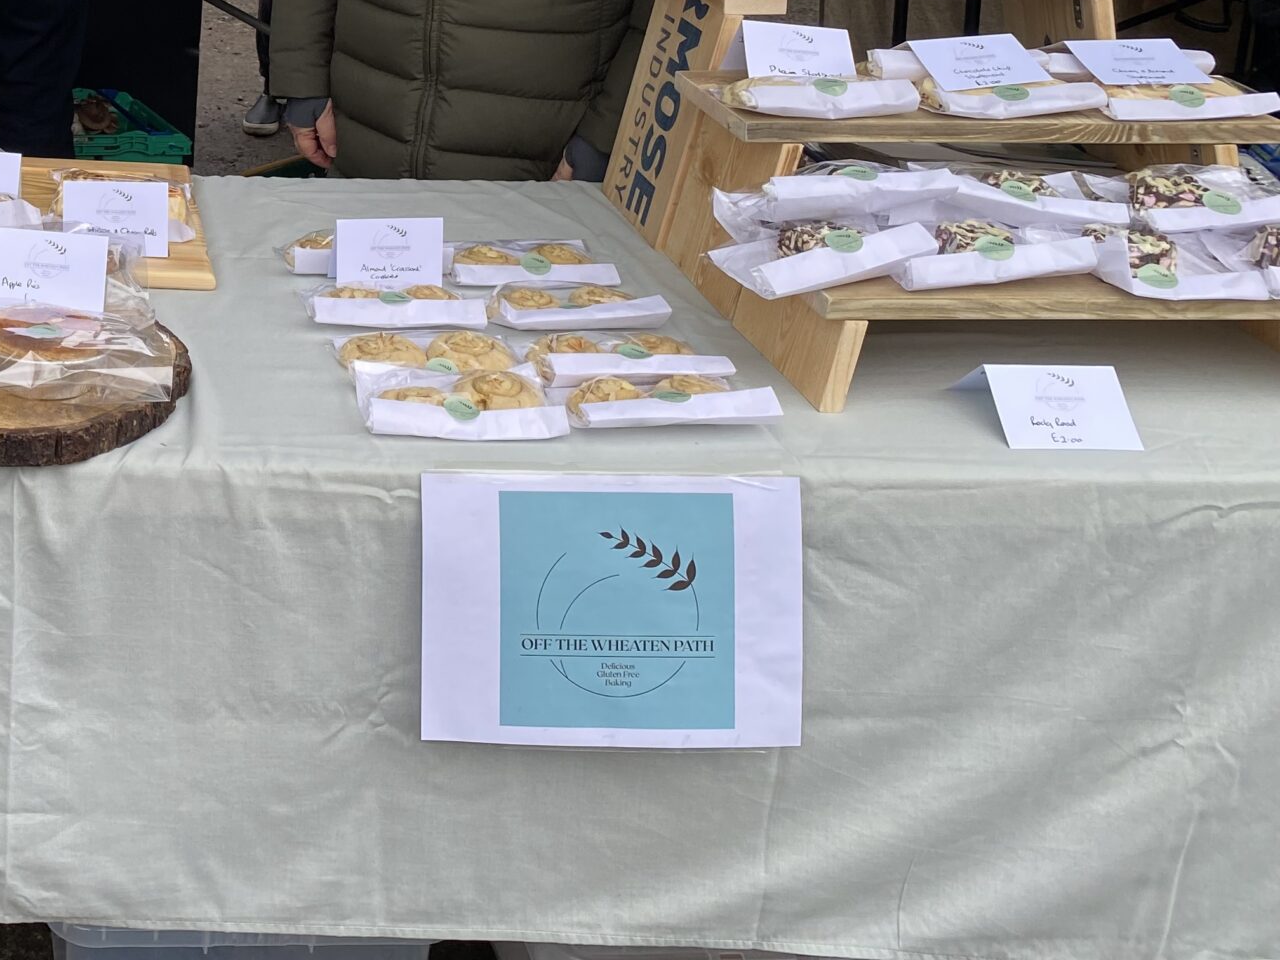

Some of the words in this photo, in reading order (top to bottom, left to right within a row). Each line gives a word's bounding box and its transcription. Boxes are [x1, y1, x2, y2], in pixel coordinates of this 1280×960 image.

[615, 13, 675, 203] INDUSTRY
[360, 263, 386, 272] Almond
[1, 276, 22, 290] Apple
[1030, 416, 1054, 429] Rocky
[1055, 417, 1077, 427] Road
[521, 638, 552, 651] OFF
[555, 638, 588, 651] THE
[591, 639, 671, 652] WHEATEN
[673, 640, 714, 652] PATH
[601, 662, 635, 670] Delicious
[596, 670, 621, 679] Gluten
[605, 679, 632, 688] Baking
